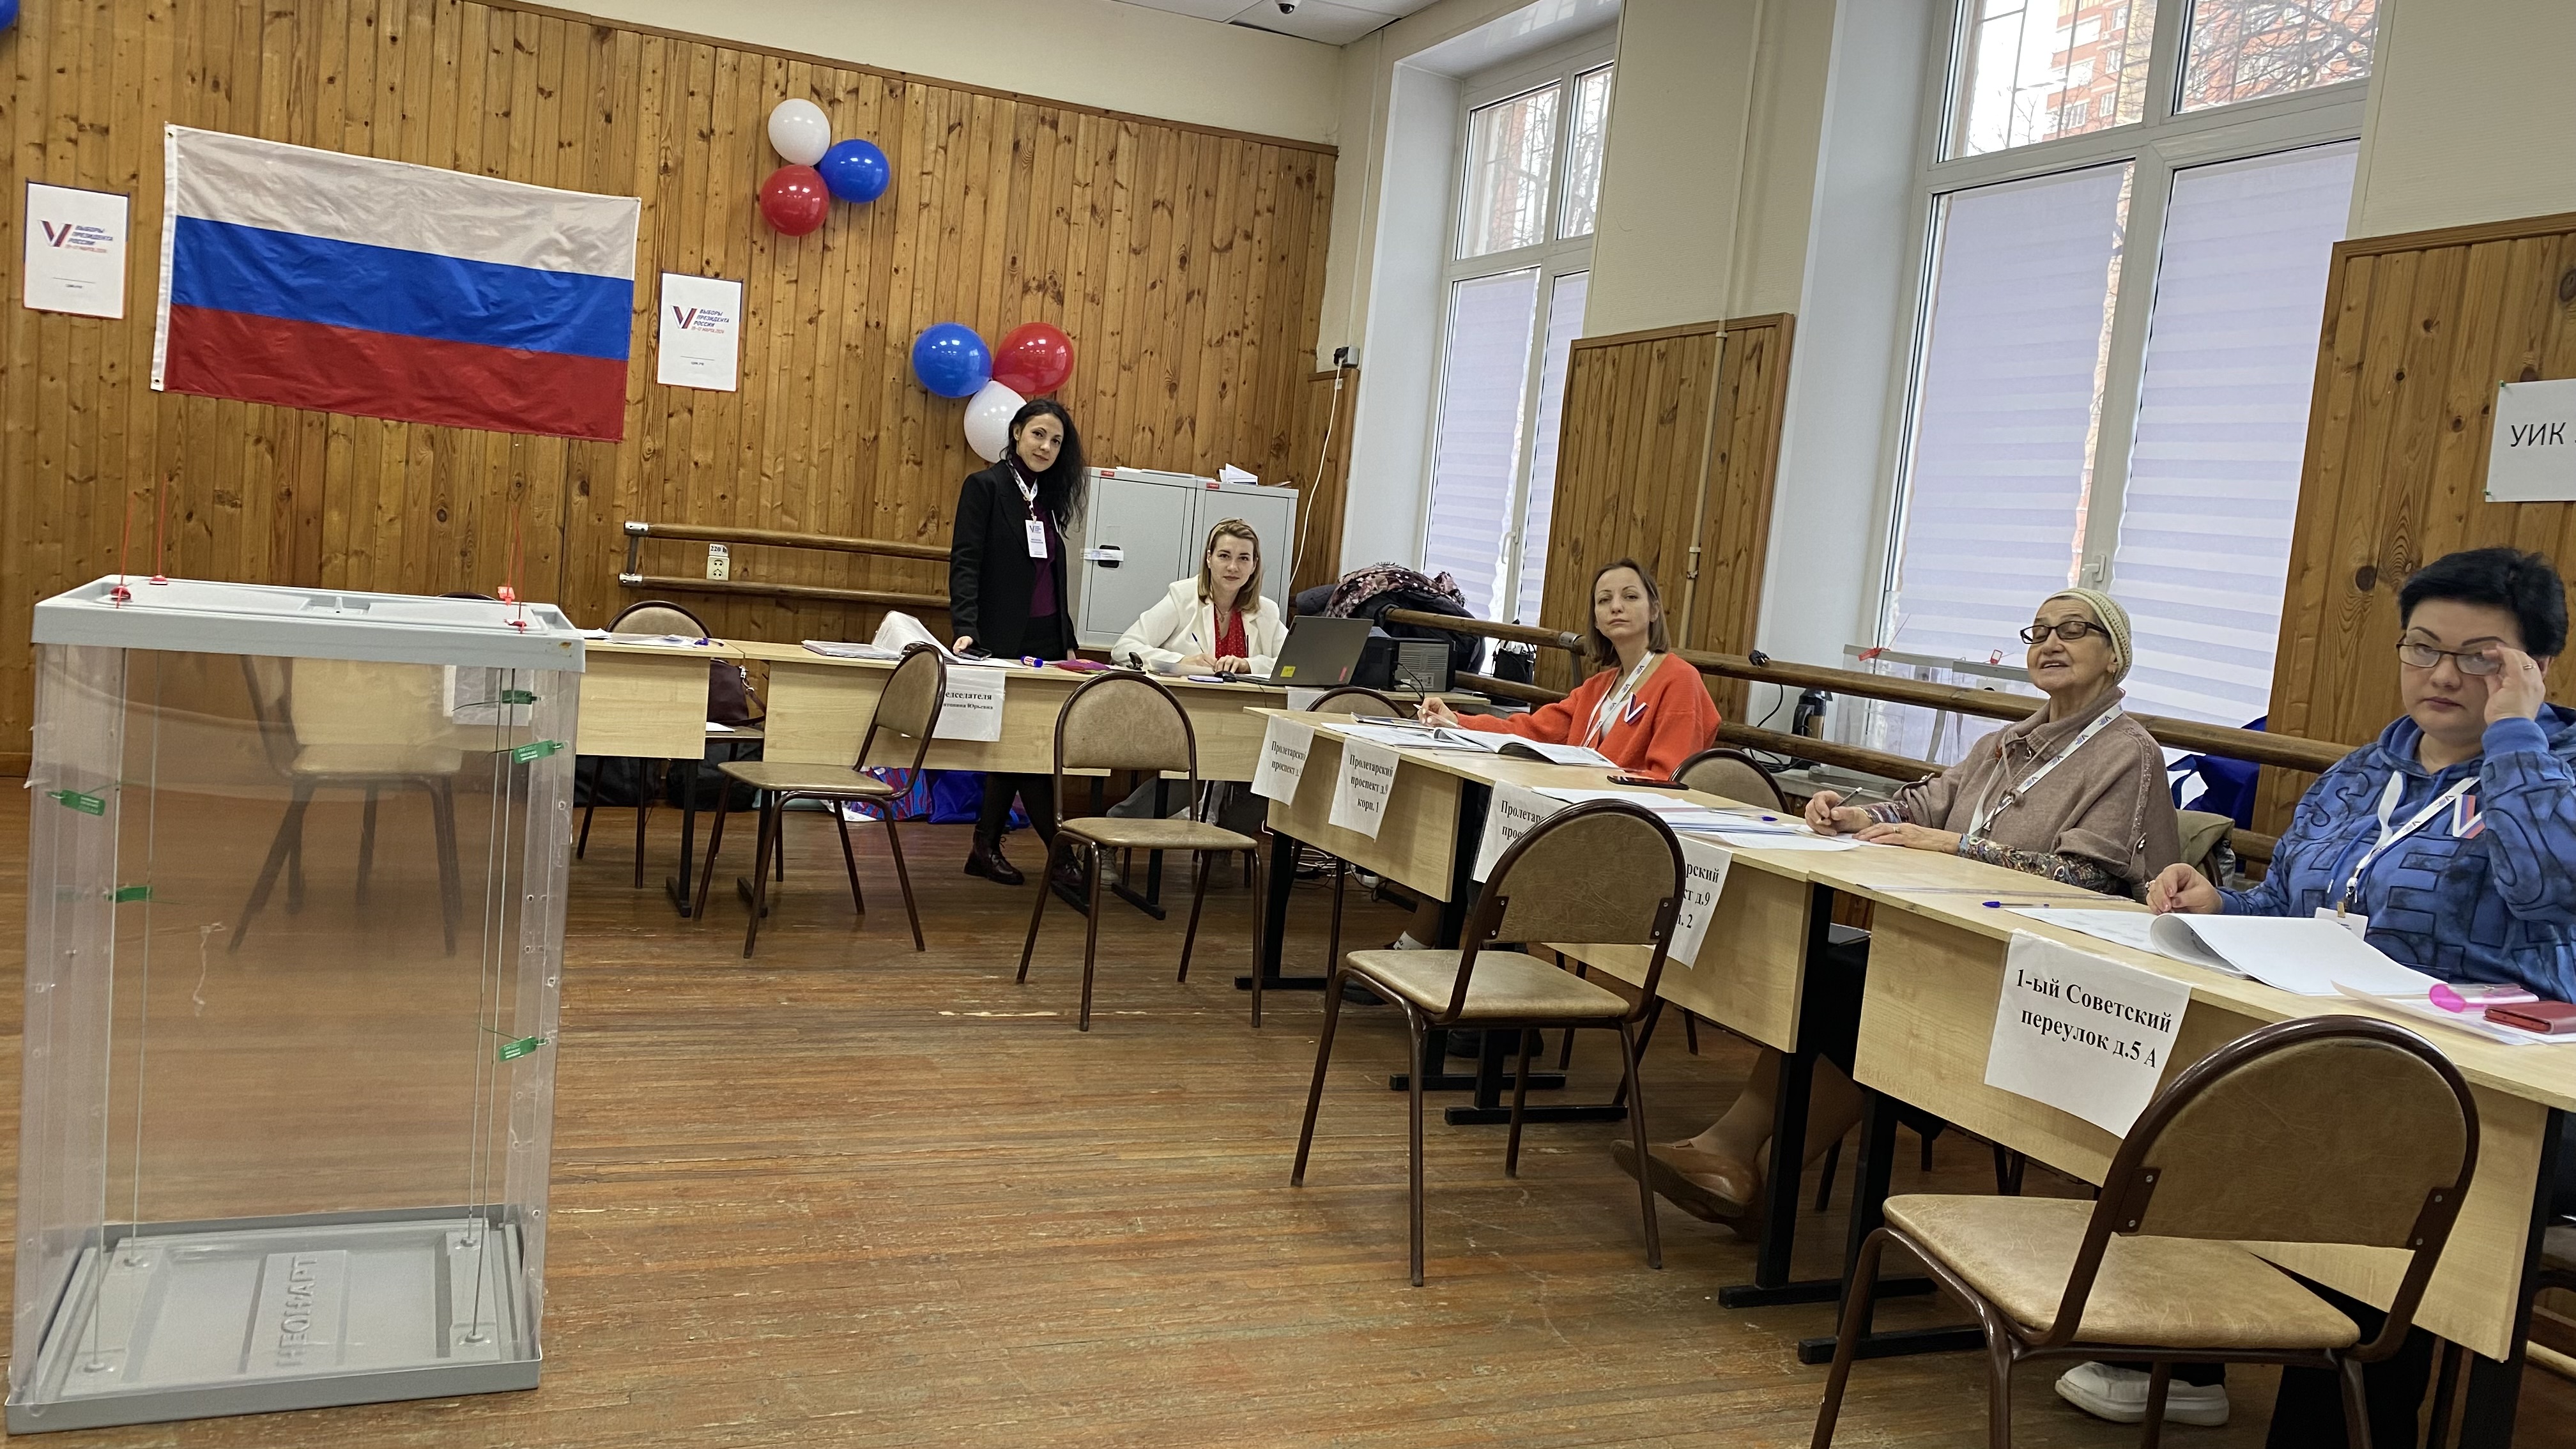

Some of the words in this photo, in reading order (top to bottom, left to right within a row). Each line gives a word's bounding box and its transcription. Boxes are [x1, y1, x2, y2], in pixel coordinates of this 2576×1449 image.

[696, 315, 730, 323] ПРЕЗИДЕНТА
[2511, 422, 2566, 447] УИК
[946, 692, 992, 700] едседателя
[1271, 740, 1307, 761] Пролетарский
[1271, 761, 1295, 775] проспект
[1350, 754, 1393, 778] Пролетарский
[1351, 776, 1379, 792] проспект
[1358, 798, 1374, 812] корп.
[1376, 801, 1379, 813] 1
[1502, 826, 1522, 840] прос
[1686, 863, 1719, 883] рский
[1694, 892, 1710, 906] д.9
[1687, 914, 1693, 928] 2
[2016, 969, 2060, 998] 1-ый
[2066, 984, 2172, 1033] Советский
[2021, 1009, 2109, 1050] переулок
[2113, 1041, 2142, 1061] д.5
[2144, 1047, 2156, 1068] А
